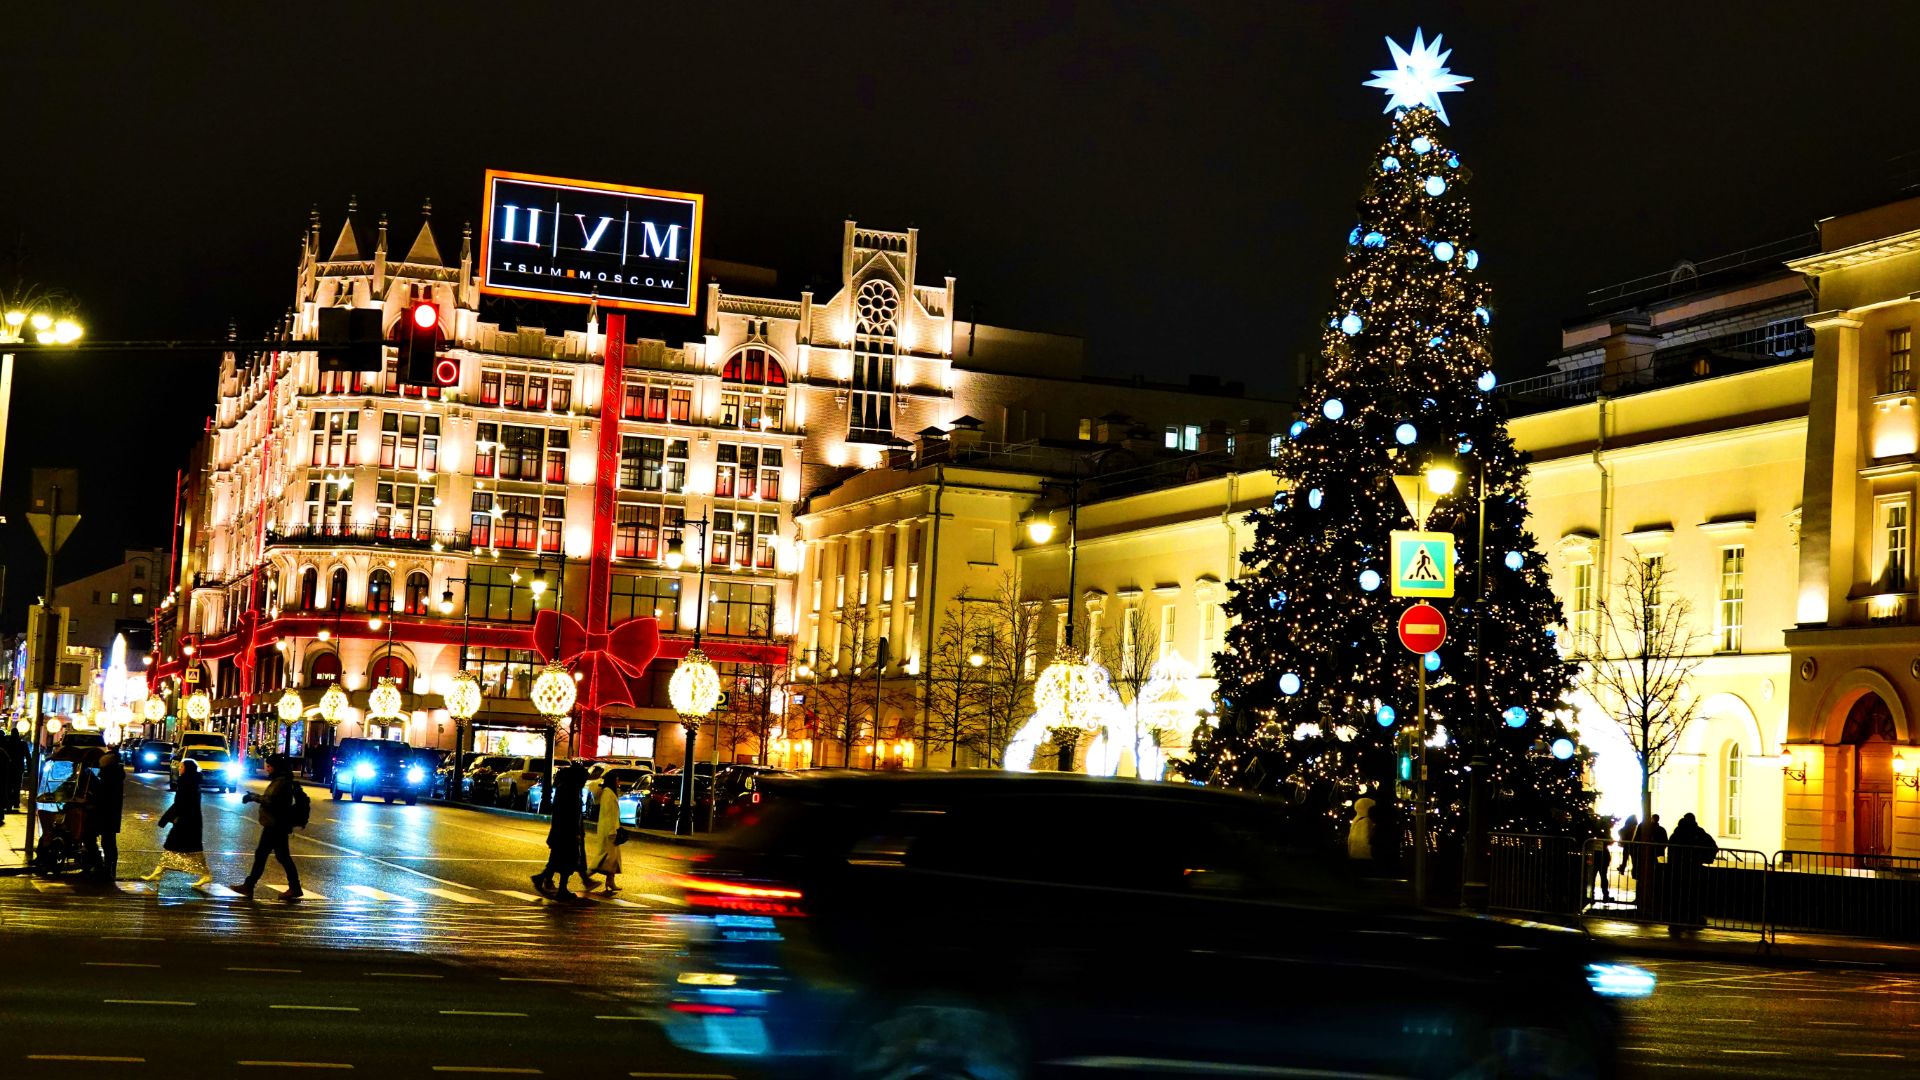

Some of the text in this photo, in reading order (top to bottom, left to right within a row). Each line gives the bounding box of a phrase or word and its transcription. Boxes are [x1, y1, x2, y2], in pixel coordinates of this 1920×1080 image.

[503, 262, 674, 289] TSUM MOSCOW
[600, 441, 614, 463] Year
[597, 487, 611, 517] Happy
